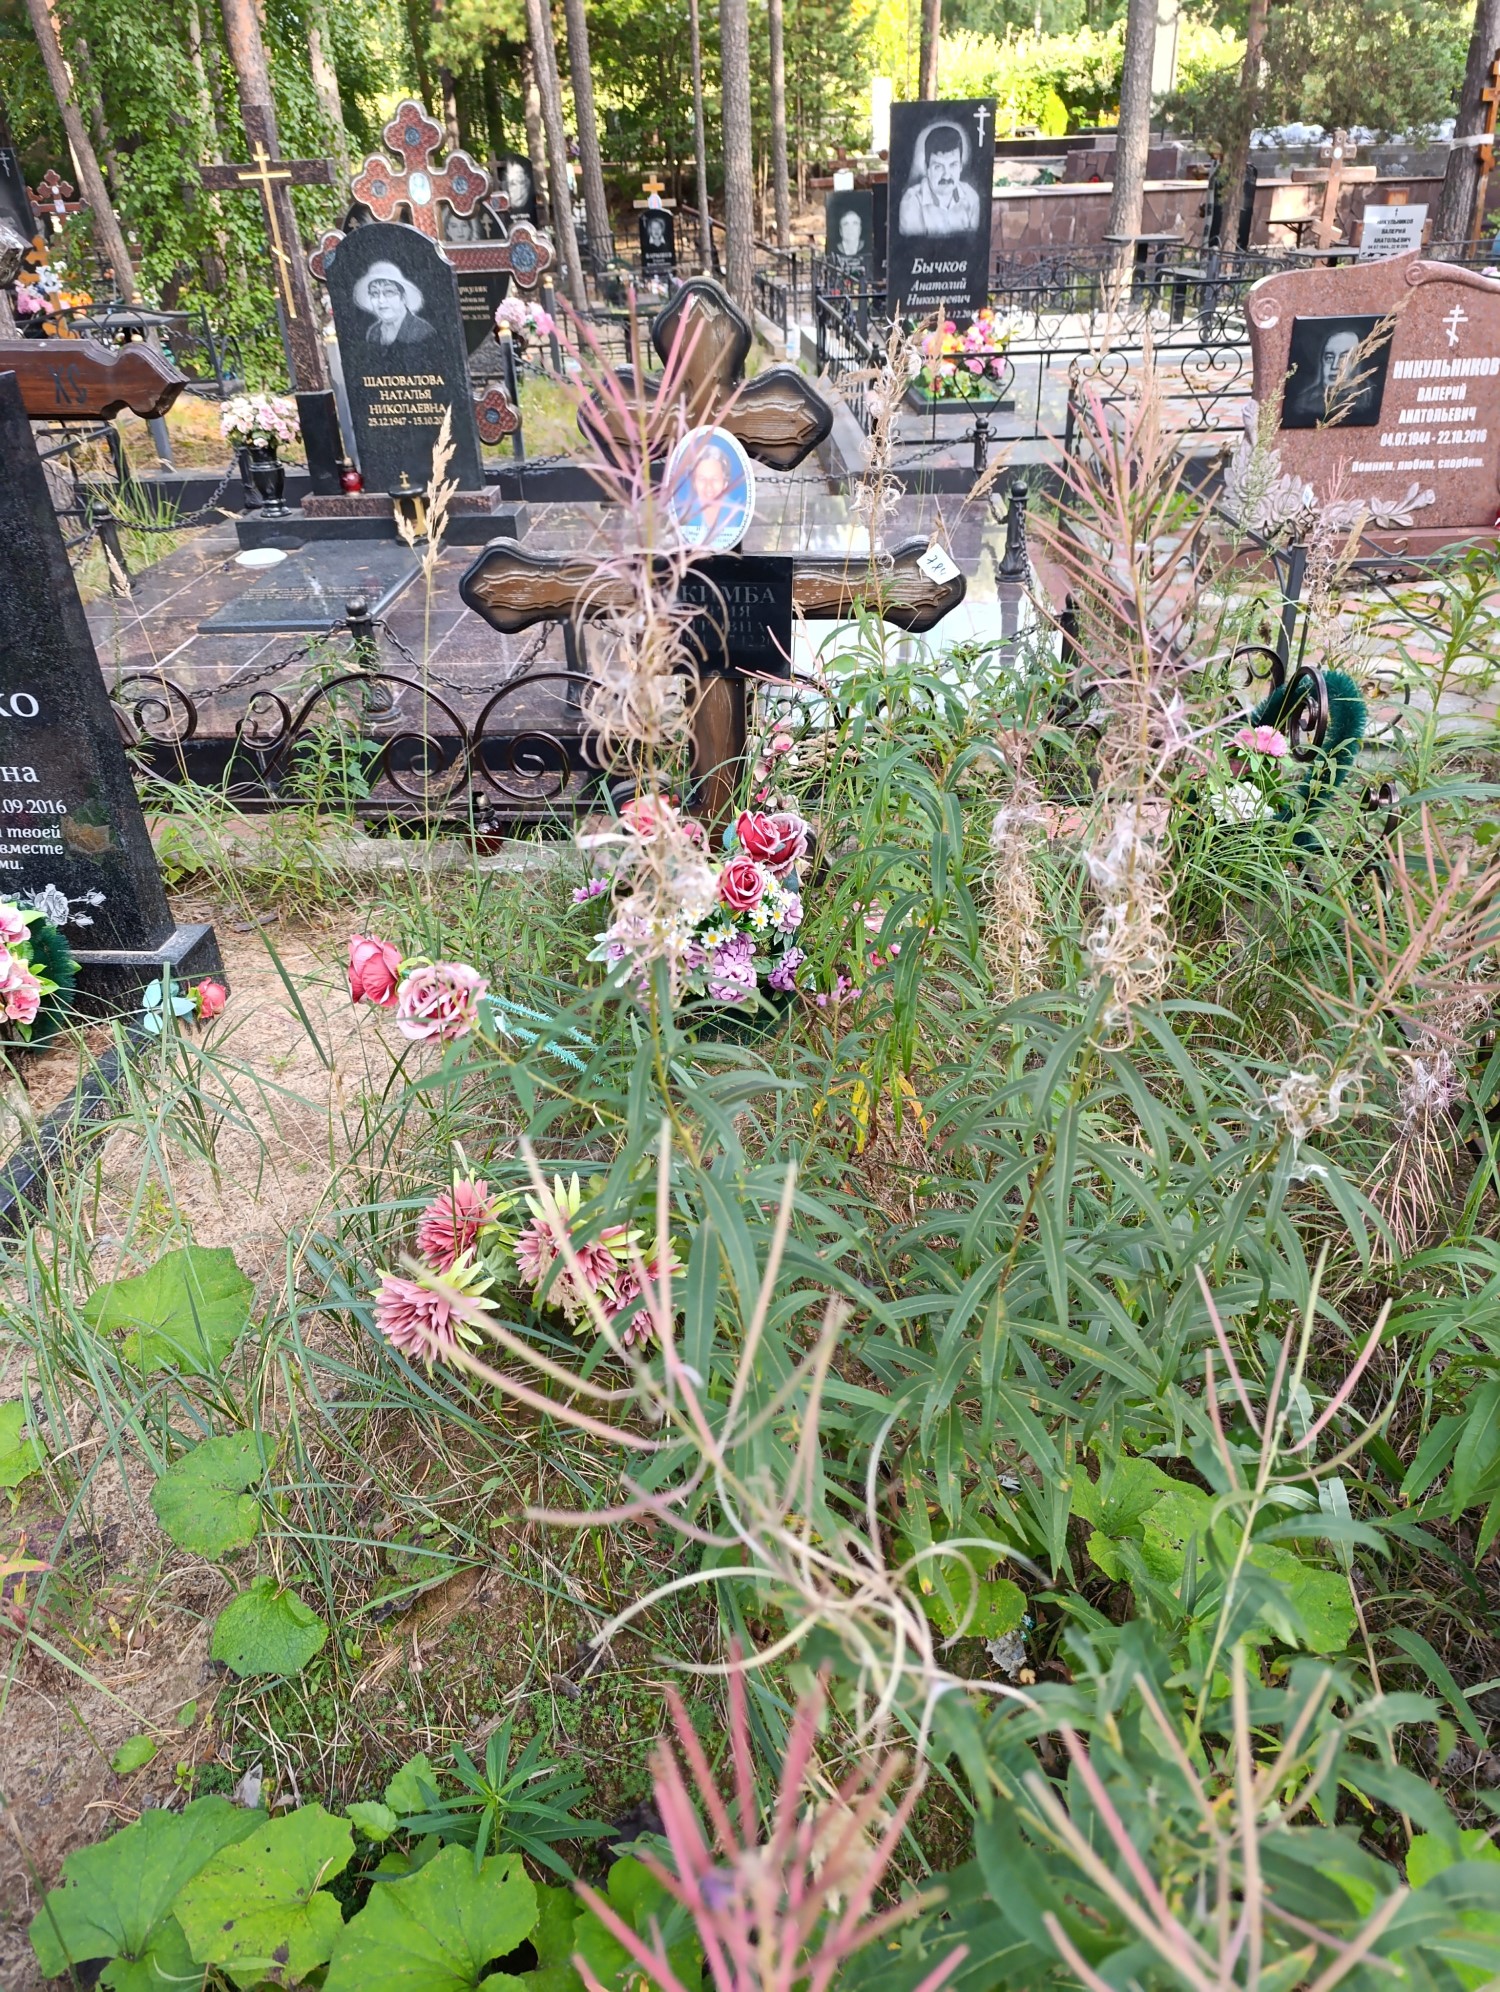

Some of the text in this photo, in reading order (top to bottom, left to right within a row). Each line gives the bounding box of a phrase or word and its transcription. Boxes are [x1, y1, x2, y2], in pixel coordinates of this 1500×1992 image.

[911, 258, 968, 275] Бычков
[910, 277, 967, 292] Анатолий
[1392, 357, 1500, 379] НИКУЛЬНИКОВ
[362, 375, 445, 387] ШАПОВАЛОВА
[379, 389, 432, 400] НАТАЛЬЯ
[1416, 382, 1467, 402] ВАЛЕРИЙ
[369, 403, 447, 415] НИКОЛАЕВНА
[1398, 406, 1477, 424] АНАТОЛЬЕВИЧ
[1380, 431, 1431, 447] 04.07.1944
[1436, 429, 1487, 445] 22.10.2016
[6, 824, 62, 839] твоей
